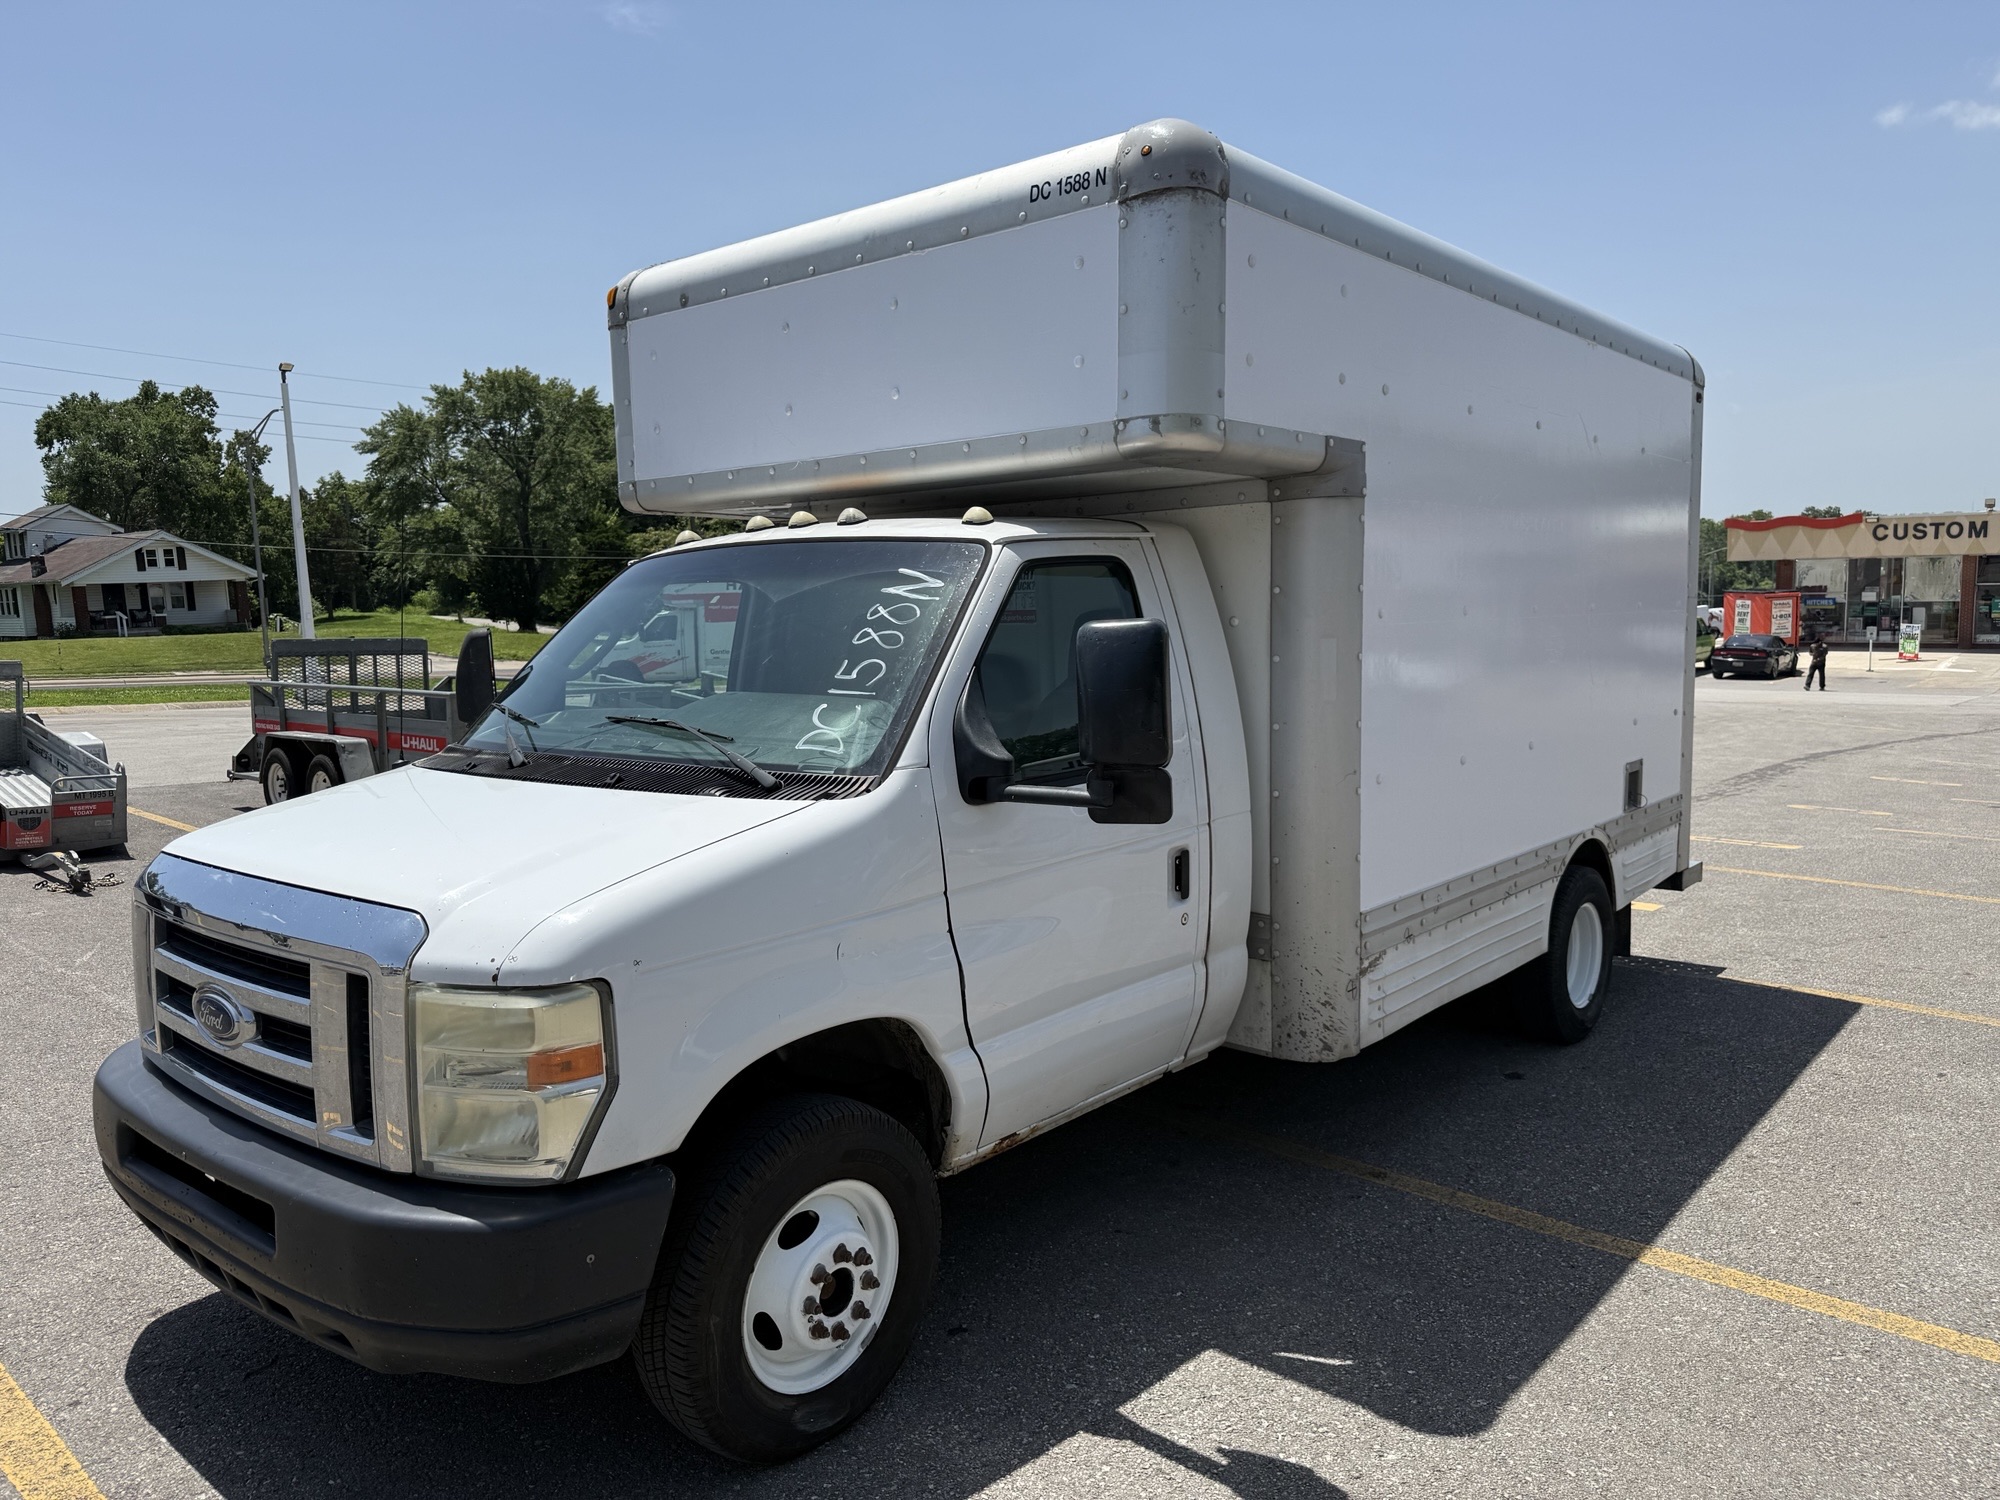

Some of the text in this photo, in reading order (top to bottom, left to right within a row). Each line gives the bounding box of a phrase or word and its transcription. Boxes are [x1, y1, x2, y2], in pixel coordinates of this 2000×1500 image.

[1029, 166, 1107, 204] DC 1588 N
[1872, 520, 1989, 542] CUSTOM
[1017, 581, 1035, 590] UCK?
[401, 735, 440, 752] U-HAUL
[74, 792, 87, 800] MT
[9, 807, 49, 816] U-HAUL
[199, 1000, 224, 1030] Ford
